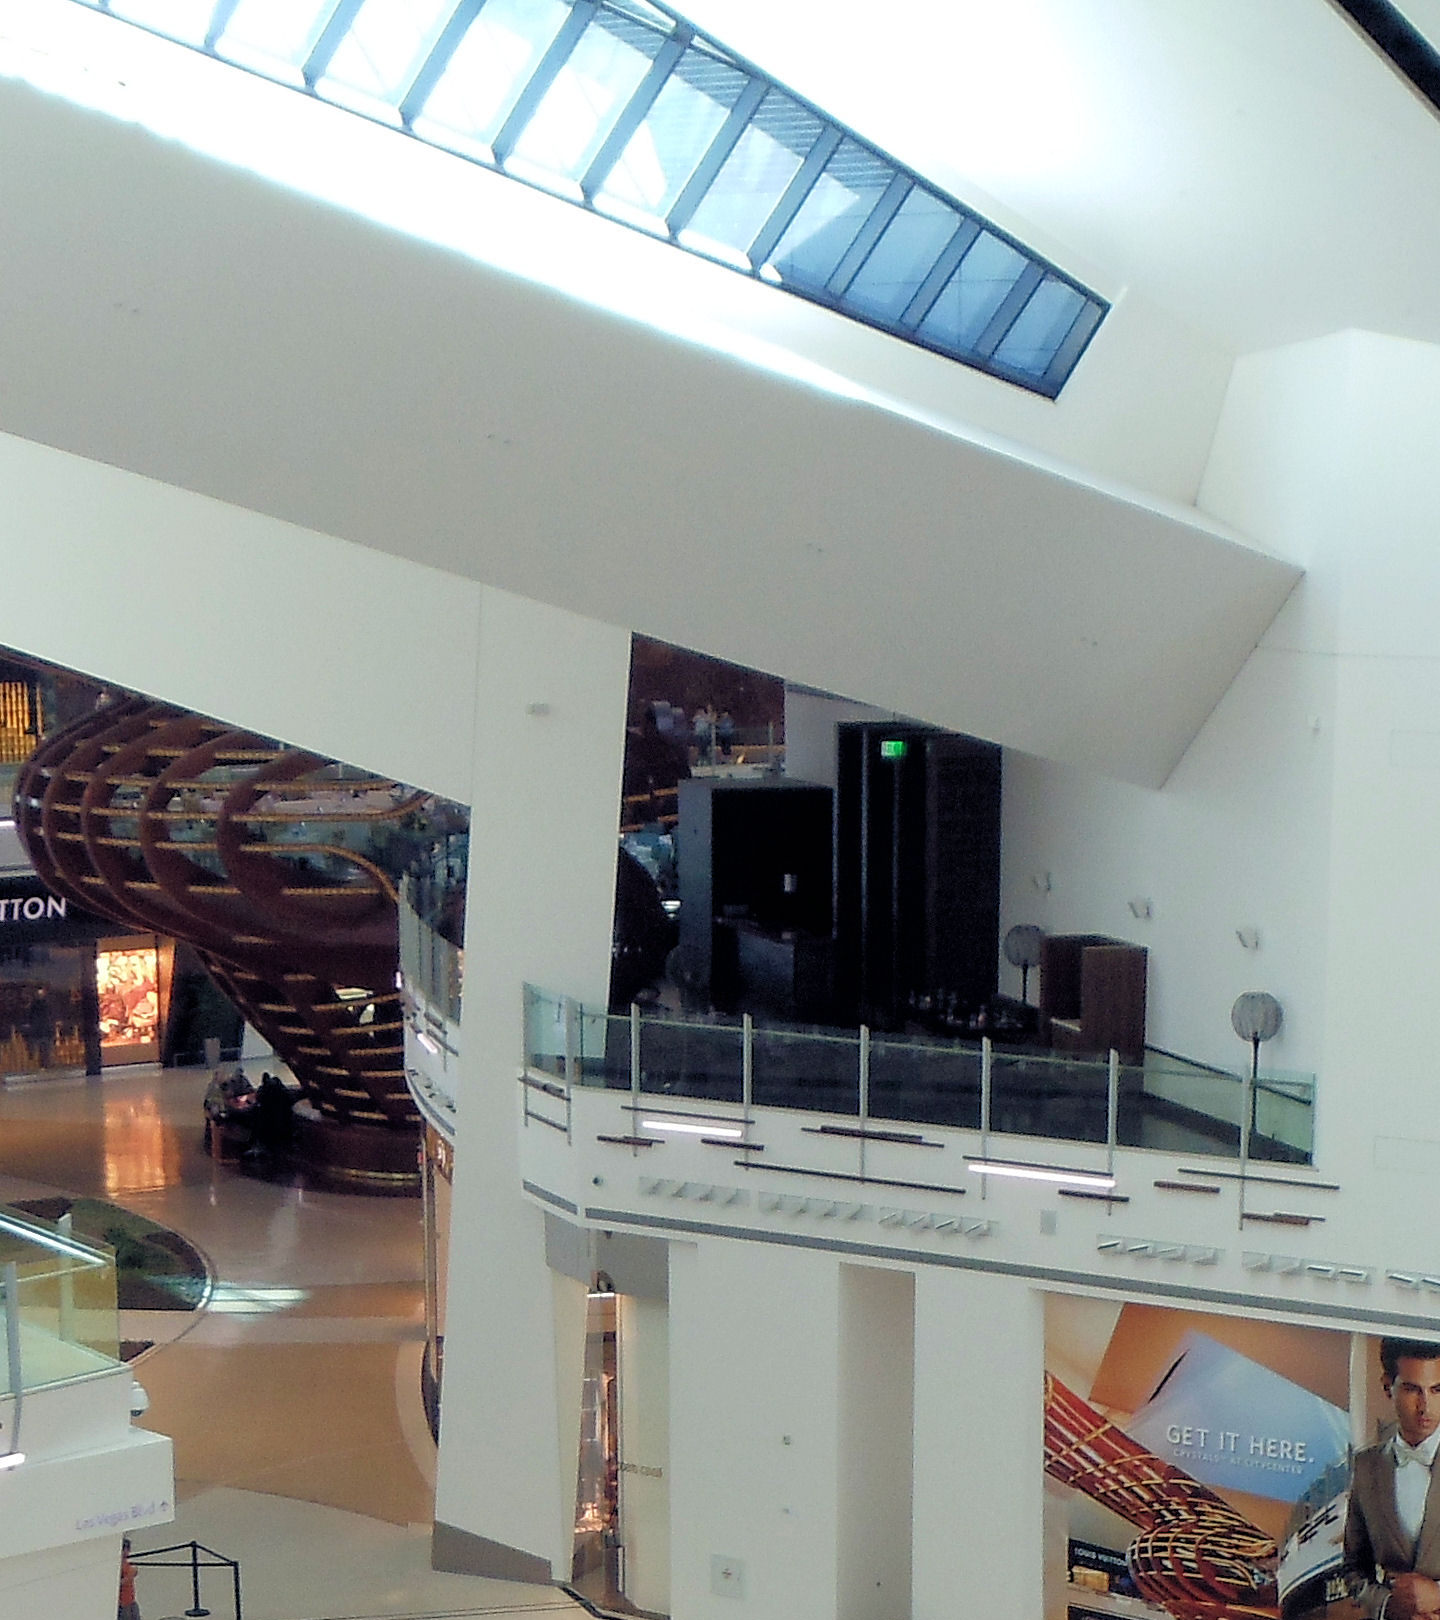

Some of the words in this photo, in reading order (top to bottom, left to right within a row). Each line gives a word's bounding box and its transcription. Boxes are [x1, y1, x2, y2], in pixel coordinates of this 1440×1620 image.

[1166, 1424, 1209, 1448] GET
[1219, 1431, 1240, 1452] IT
[1249, 1435, 1315, 1463] HERE.
